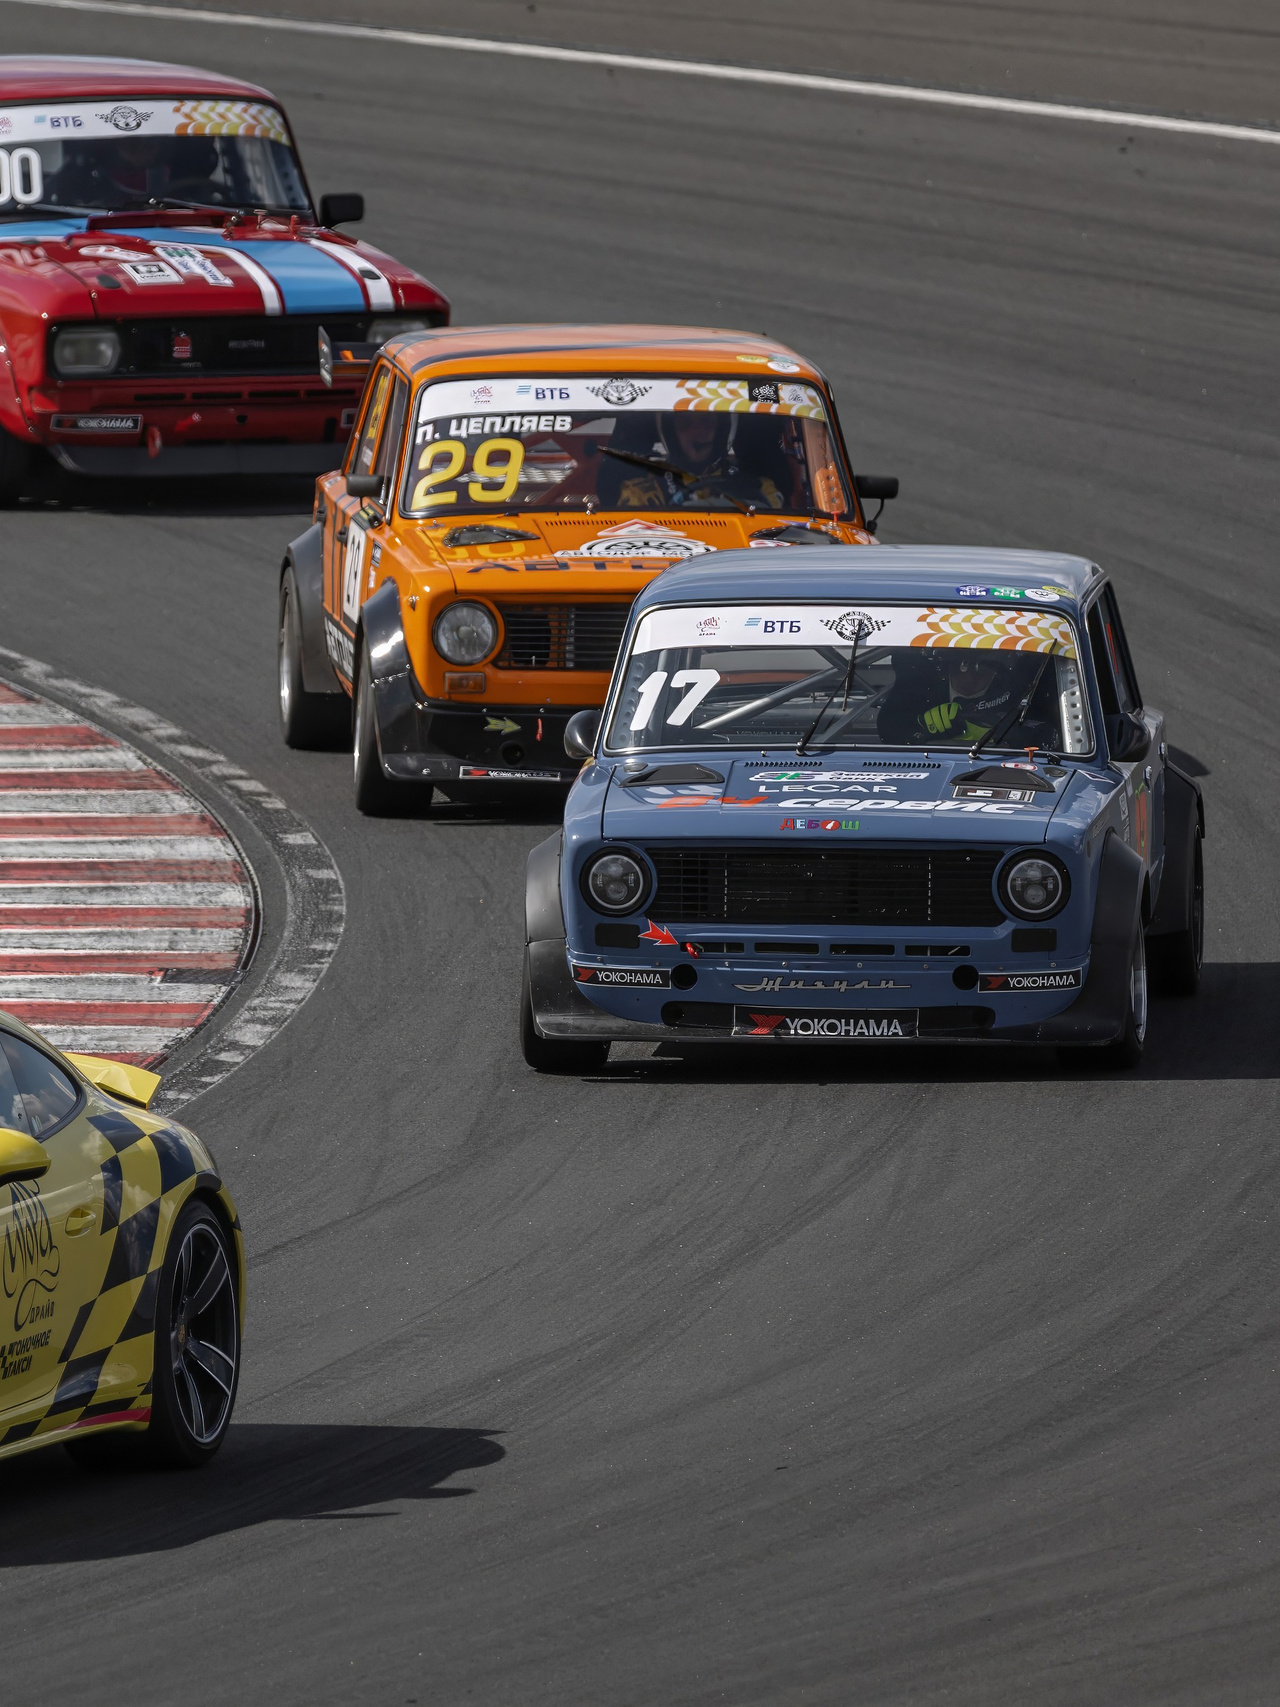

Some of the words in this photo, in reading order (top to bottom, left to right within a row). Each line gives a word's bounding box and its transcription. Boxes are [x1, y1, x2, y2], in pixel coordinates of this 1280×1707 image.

[535, 387, 570, 400] ВТБ
[449, 415, 573, 439] ЦЕПЛЯЕВ
[411, 437, 526, 511] 29
[763, 620, 801, 633] ВТБ
[630, 669, 721, 731] 17
[758, 785, 898, 793] LECAR
[777, 798, 1024, 814] сервис
[597, 970, 663, 984] YOKOHAMA
[1008, 974, 1075, 988] YOKOHAMA
[785, 1018, 904, 1036] YOKOHAMA
